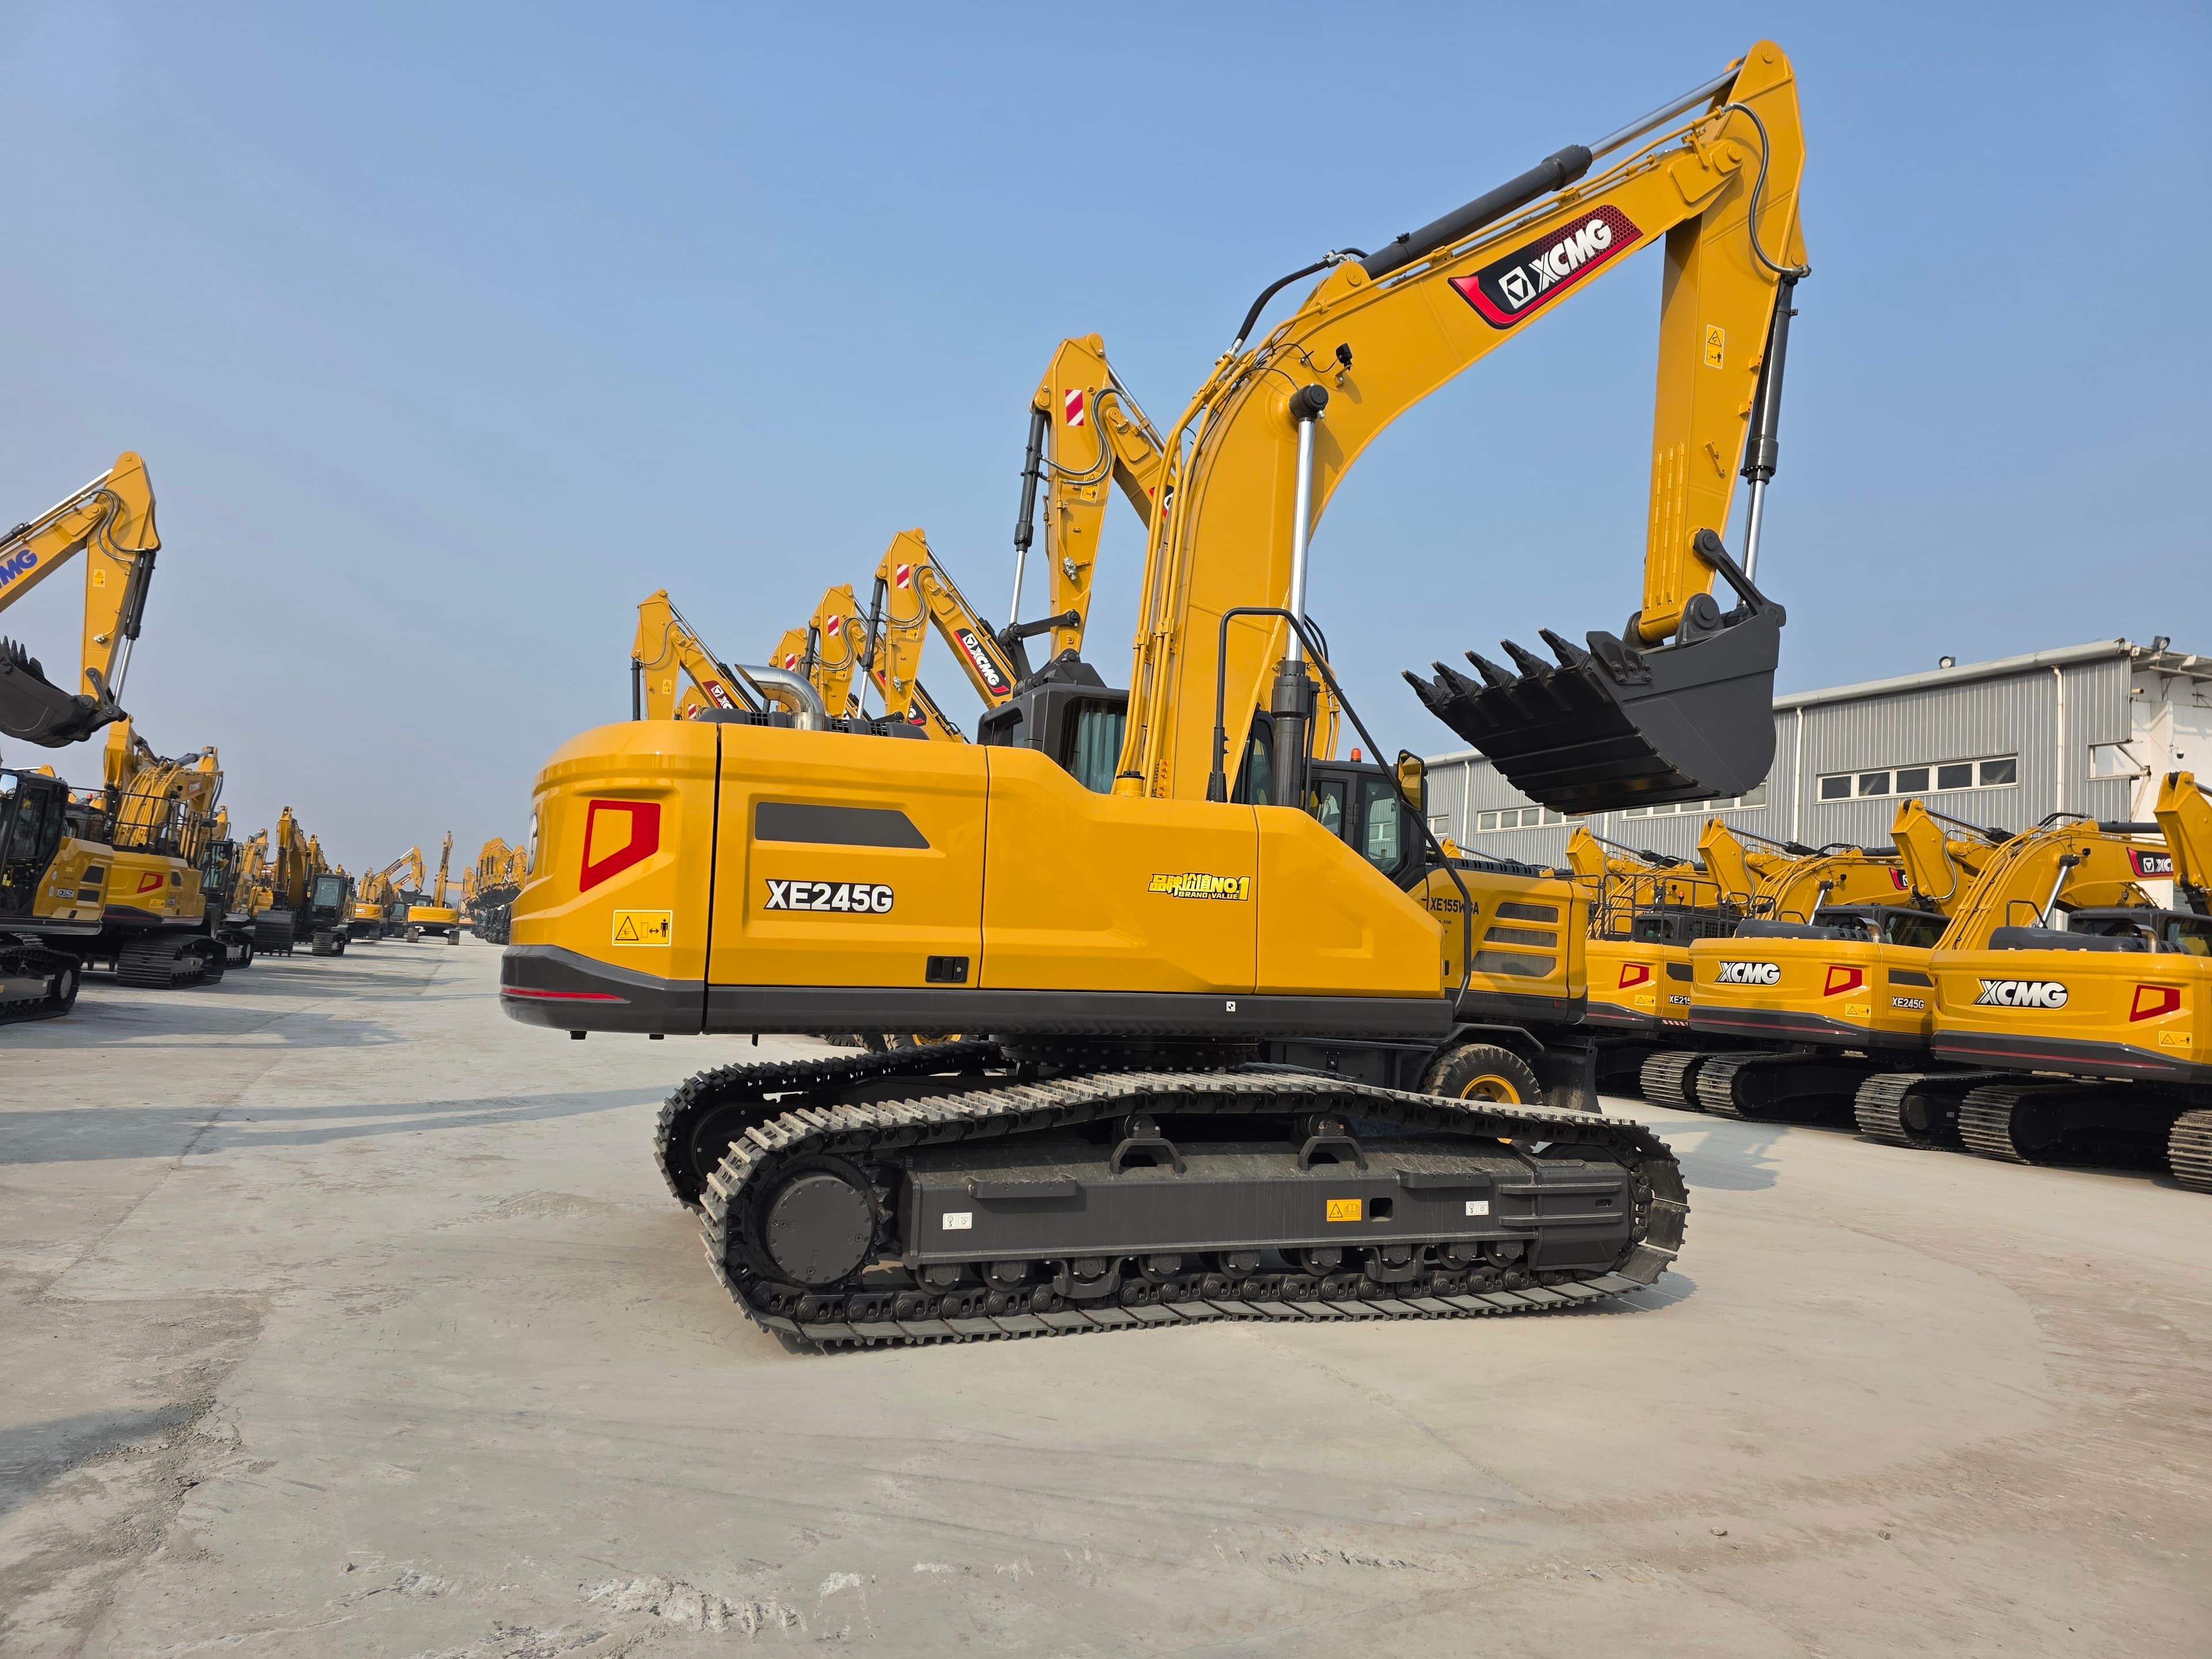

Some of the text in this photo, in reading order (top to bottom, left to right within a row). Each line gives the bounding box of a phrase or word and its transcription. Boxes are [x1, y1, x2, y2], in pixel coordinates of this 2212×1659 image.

[1528, 219, 1612, 293] XCMG
[0, 549, 37, 589] MG
[970, 646, 999, 685] XCMG
[2156, 858, 2173, 872] XC
[766, 880, 892, 912] XE245G
[1717, 962, 1781, 984] XCMG
[1892, 997, 1925, 1009] XE245G
[1976, 980, 2067, 1008] XCMG
